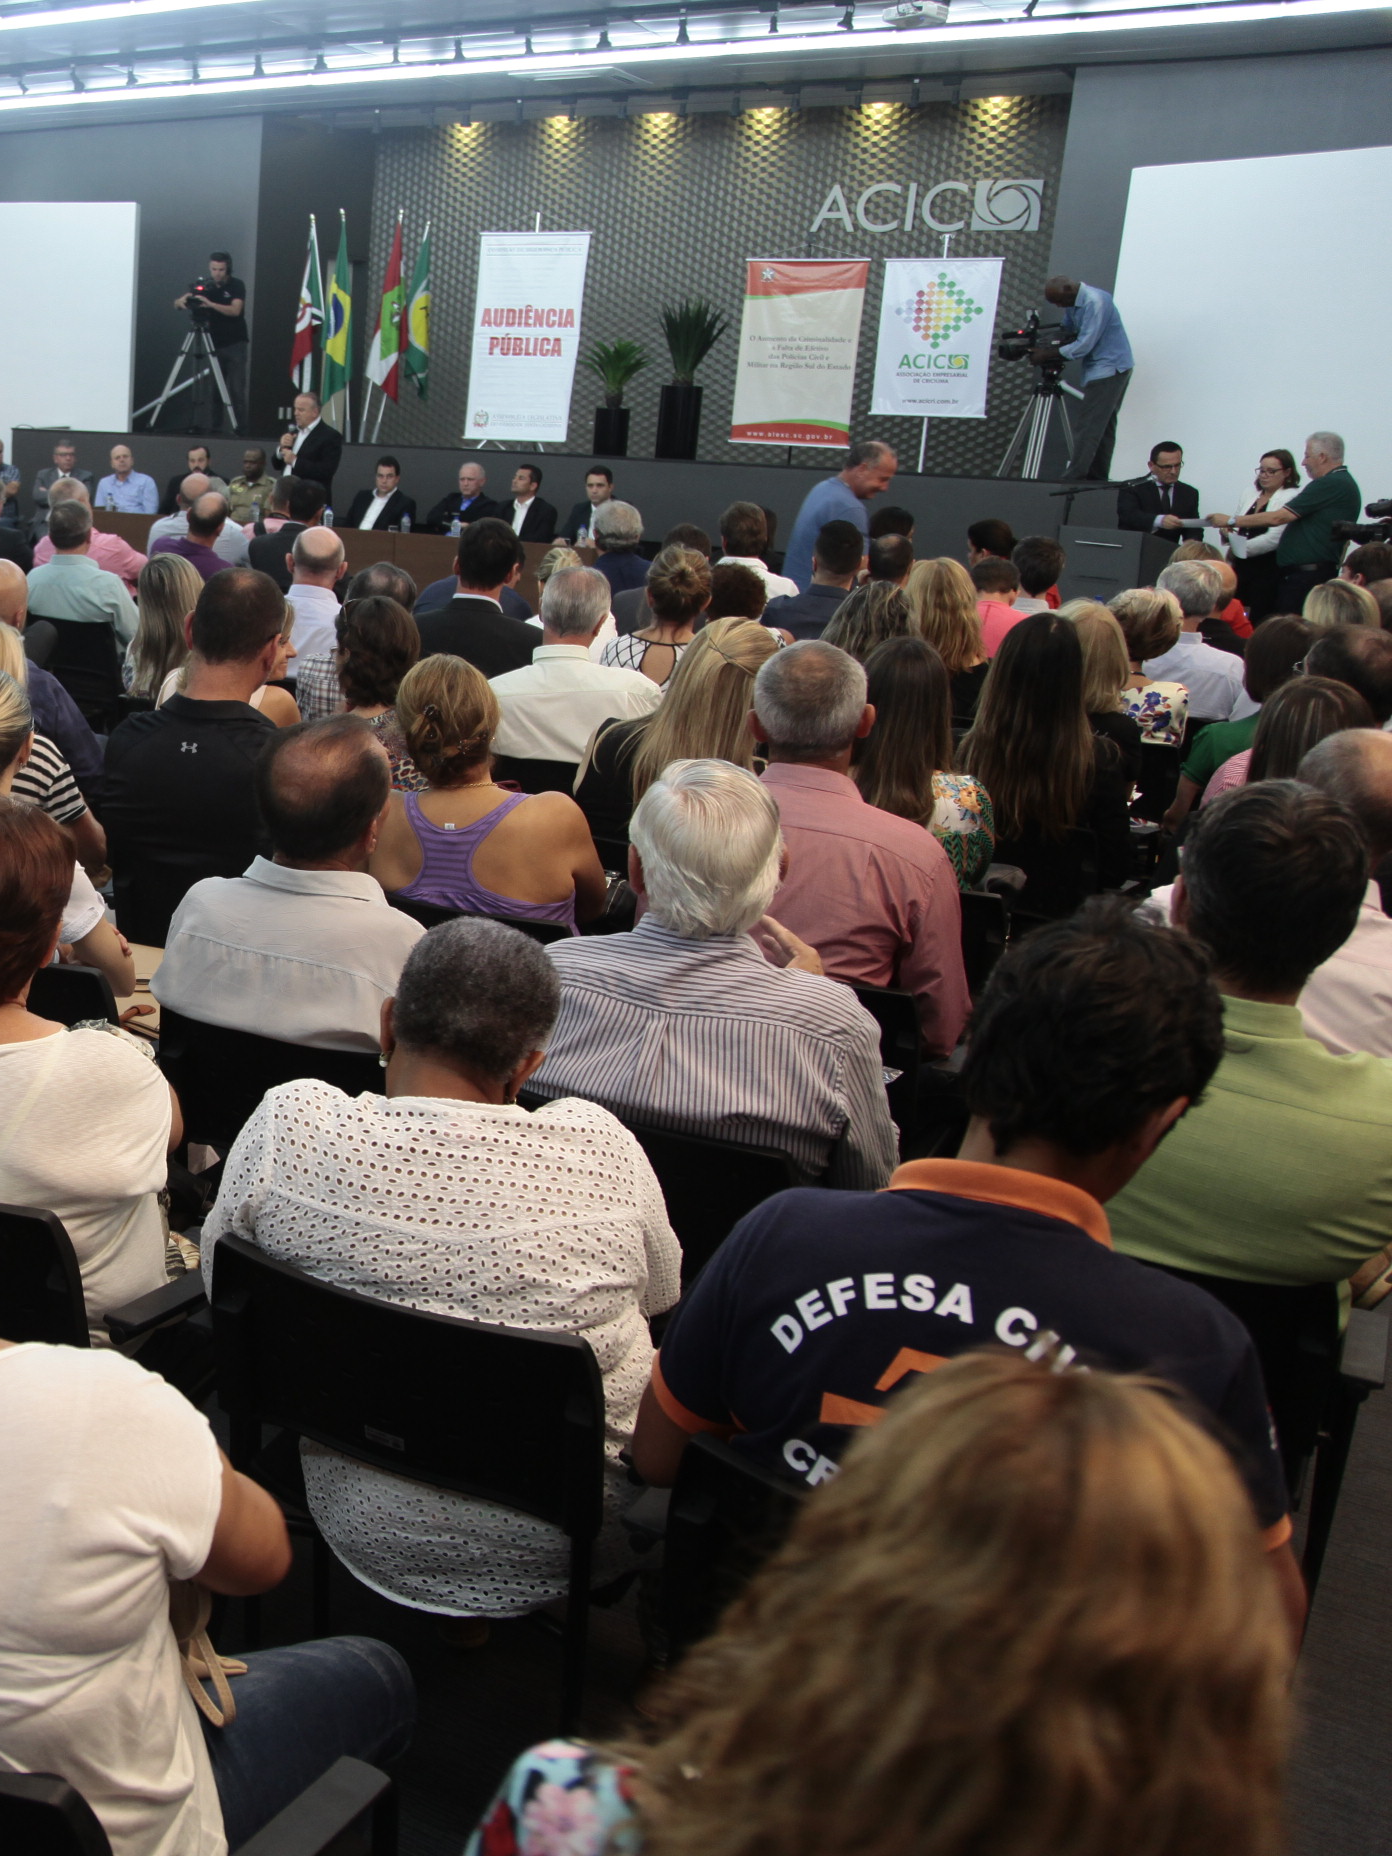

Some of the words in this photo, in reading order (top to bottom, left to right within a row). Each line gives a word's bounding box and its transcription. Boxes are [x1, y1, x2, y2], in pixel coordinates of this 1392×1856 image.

[809, 181, 969, 232] ACIC
[480, 304, 575, 329] AUDIÊNCIA
[488, 333, 562, 357] PÚBLICA
[898, 354, 946, 369] ACIC
[770, 1272, 974, 1355] DEFESA
